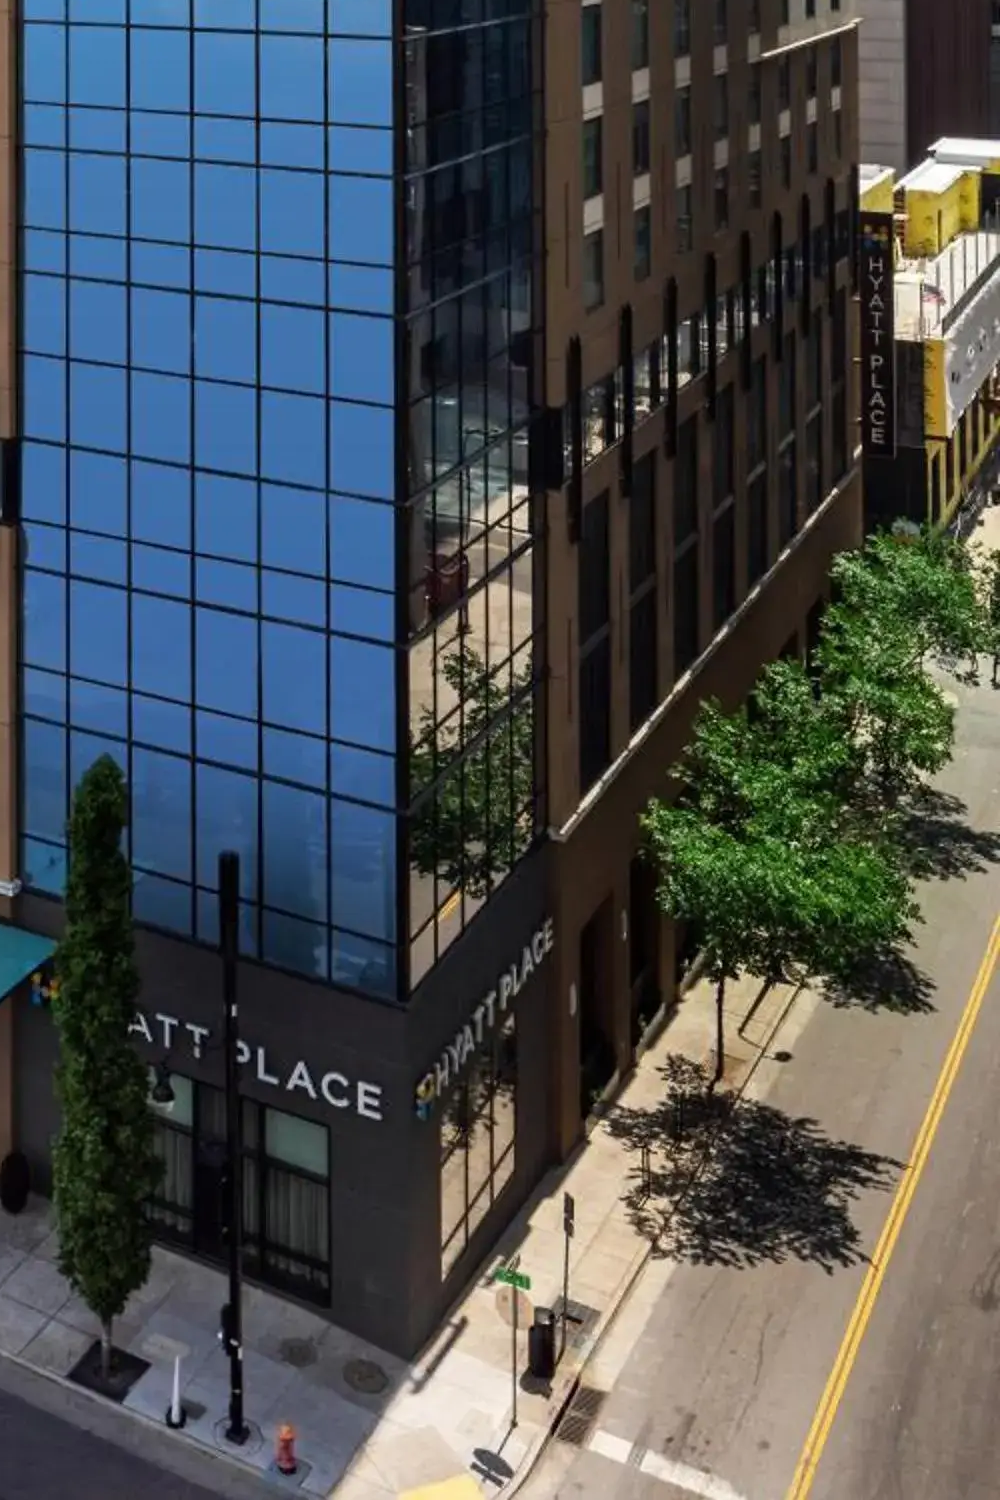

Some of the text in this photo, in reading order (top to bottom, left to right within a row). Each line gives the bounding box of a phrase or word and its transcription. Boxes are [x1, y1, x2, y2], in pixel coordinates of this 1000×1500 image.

[867, 257, 886, 445] HYATT PLACE
[127, 1012, 209, 1059] ATT
[434, 917, 554, 1096] HYATT PLACE
